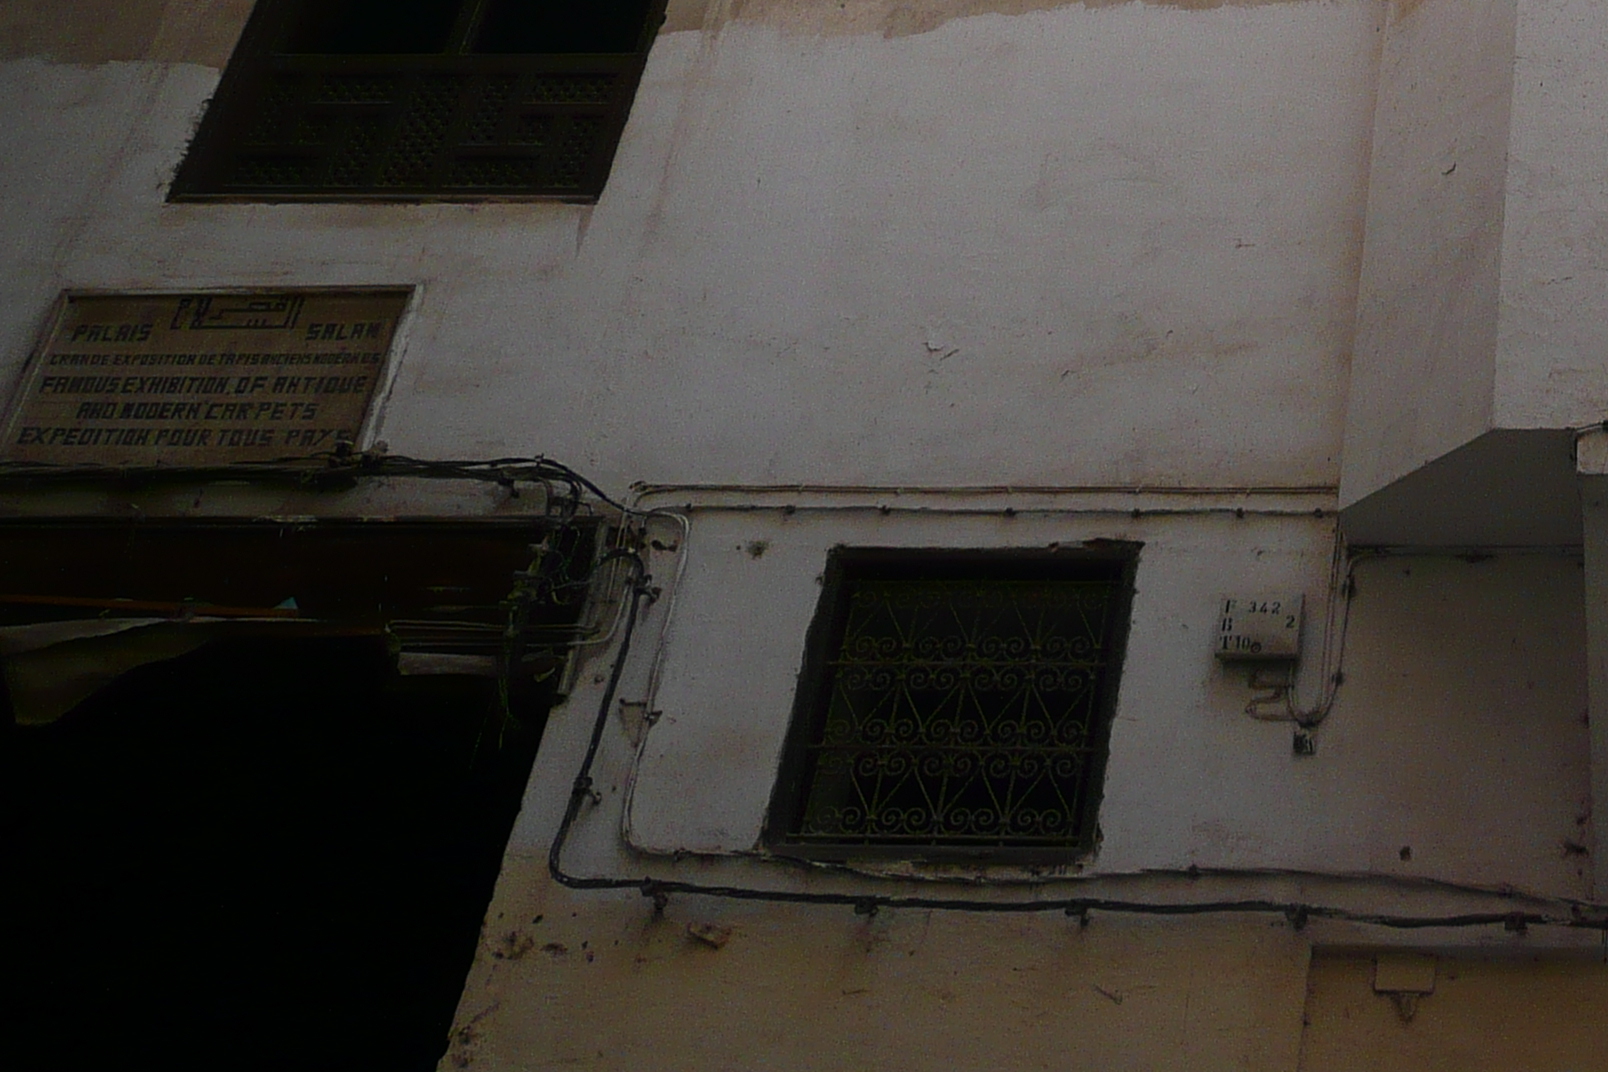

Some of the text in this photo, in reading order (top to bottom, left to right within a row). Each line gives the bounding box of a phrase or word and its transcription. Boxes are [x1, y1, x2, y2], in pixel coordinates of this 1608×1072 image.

[71, 324, 153, 342] PALAIS
[305, 323, 380, 340] SALAM
[113, 353, 199, 365] EXPOSITION
[199, 353, 215, 365] DE
[218, 353, 260, 365] TAPIS
[261, 353, 310, 365] ANCIENS
[39, 377, 121, 393] FAMOUS
[235, 377, 267, 393] OF
[272, 376, 367, 393] ANTIQUE
[76, 403, 117, 419] AND
[120, 403, 201, 419] MODERN
[17, 427, 150, 445] EXPEDITION
[154, 429, 213, 445] POUR
[217, 429, 275, 446] TOUS
[1286, 615, 1295, 628] 2
